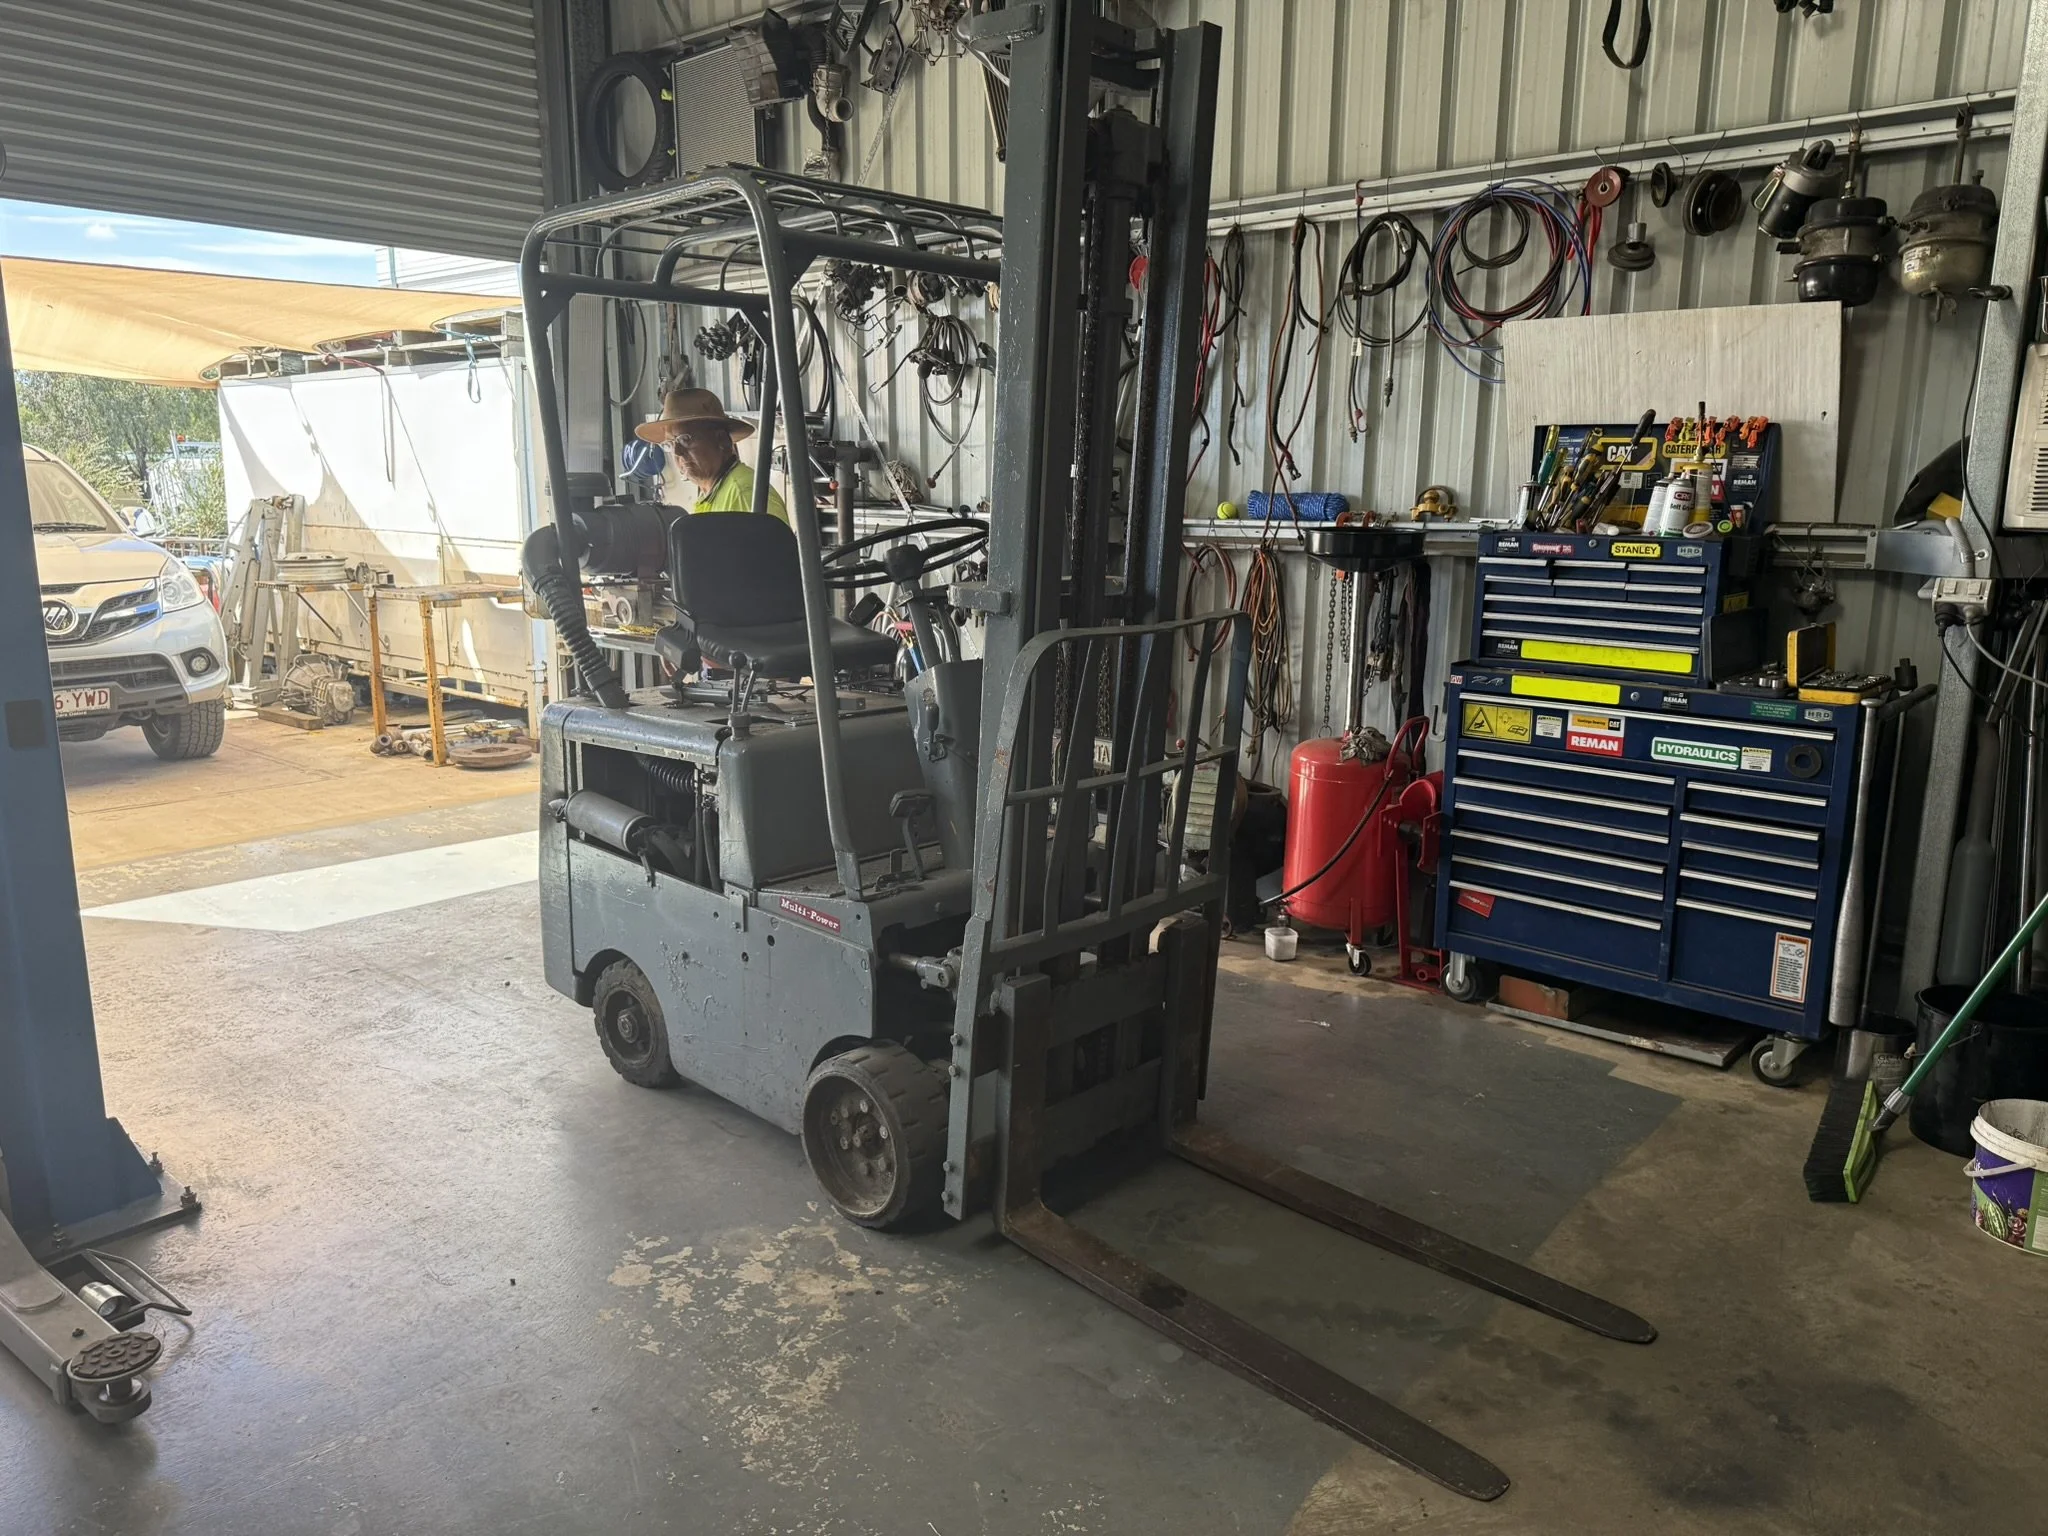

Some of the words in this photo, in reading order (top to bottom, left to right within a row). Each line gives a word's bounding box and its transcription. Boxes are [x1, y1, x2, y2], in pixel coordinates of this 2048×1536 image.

[1606, 445, 1633, 462] CAT
[1615, 545, 1657, 555] STANLEY
[1609, 720, 1621, 729] CAT
[1571, 736, 1619, 752] REMAN
[1657, 743, 1737, 762] HYDRAULICS
[781, 898, 839, 929] Multi-Power
